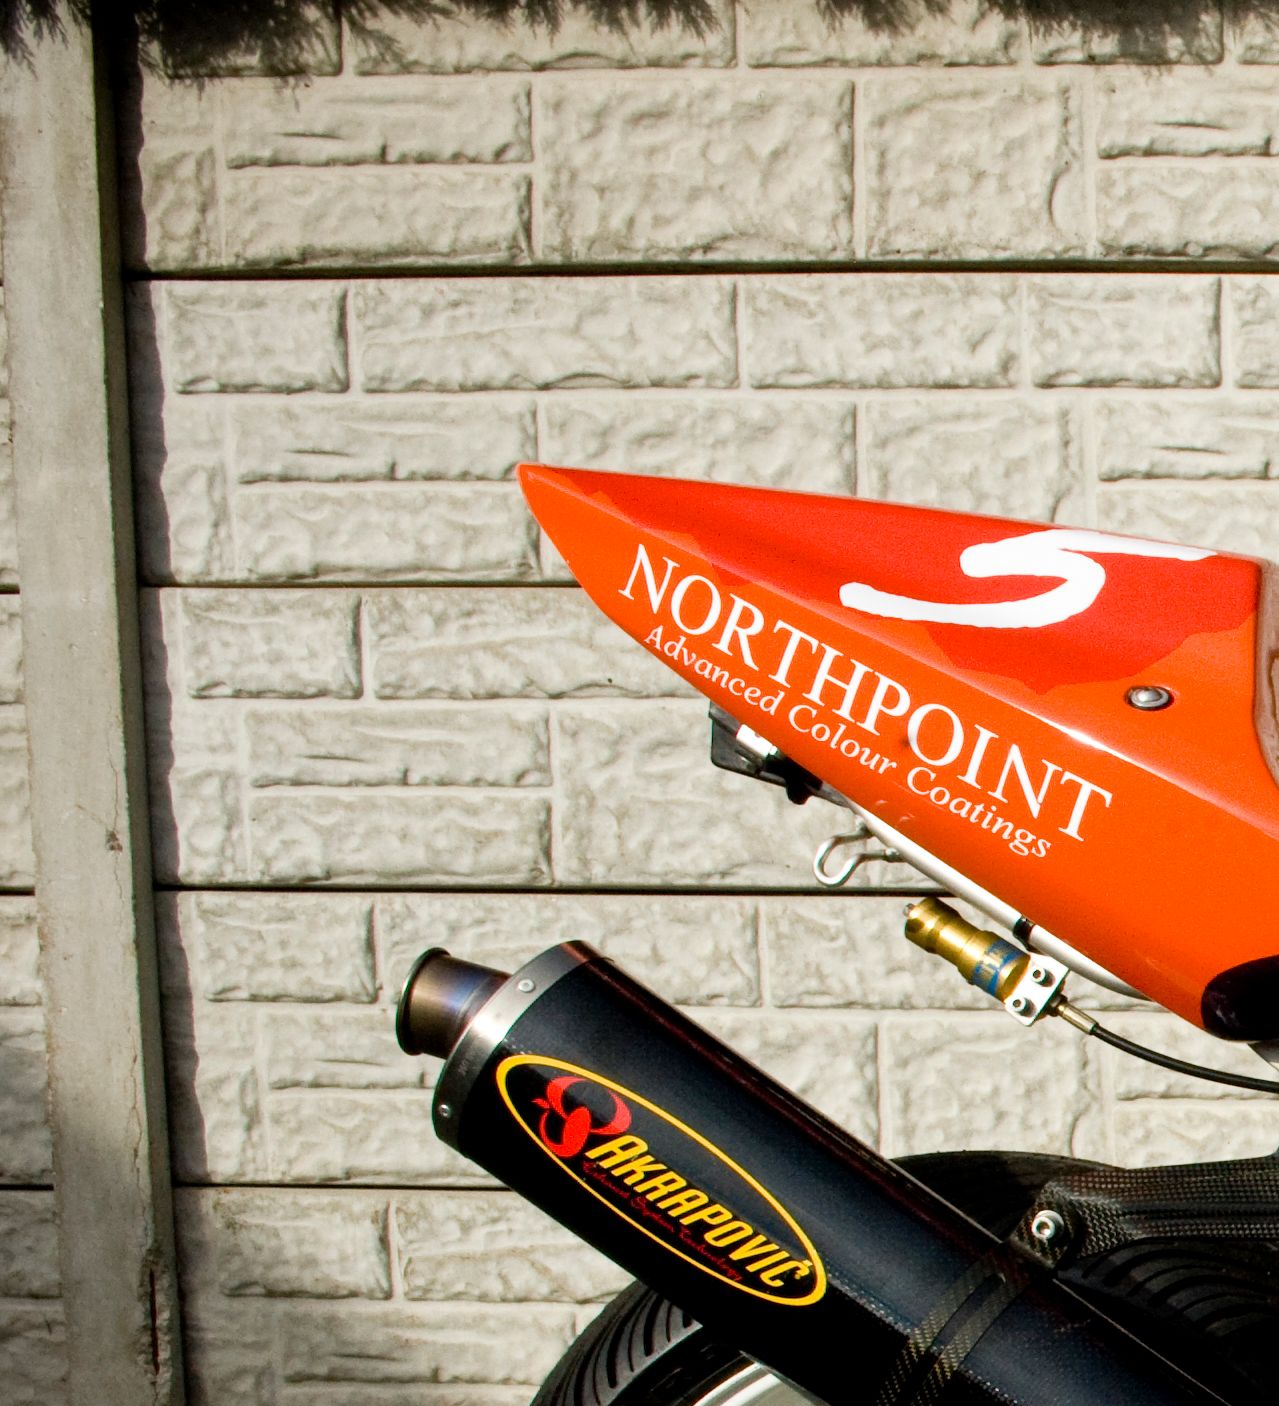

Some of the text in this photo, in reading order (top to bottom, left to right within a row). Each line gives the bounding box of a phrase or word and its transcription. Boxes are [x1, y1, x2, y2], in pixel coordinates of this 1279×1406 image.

[617, 543, 1112, 843] NORTHPOINT
[644, 625, 1053, 860] Advanced Colour Coatings
